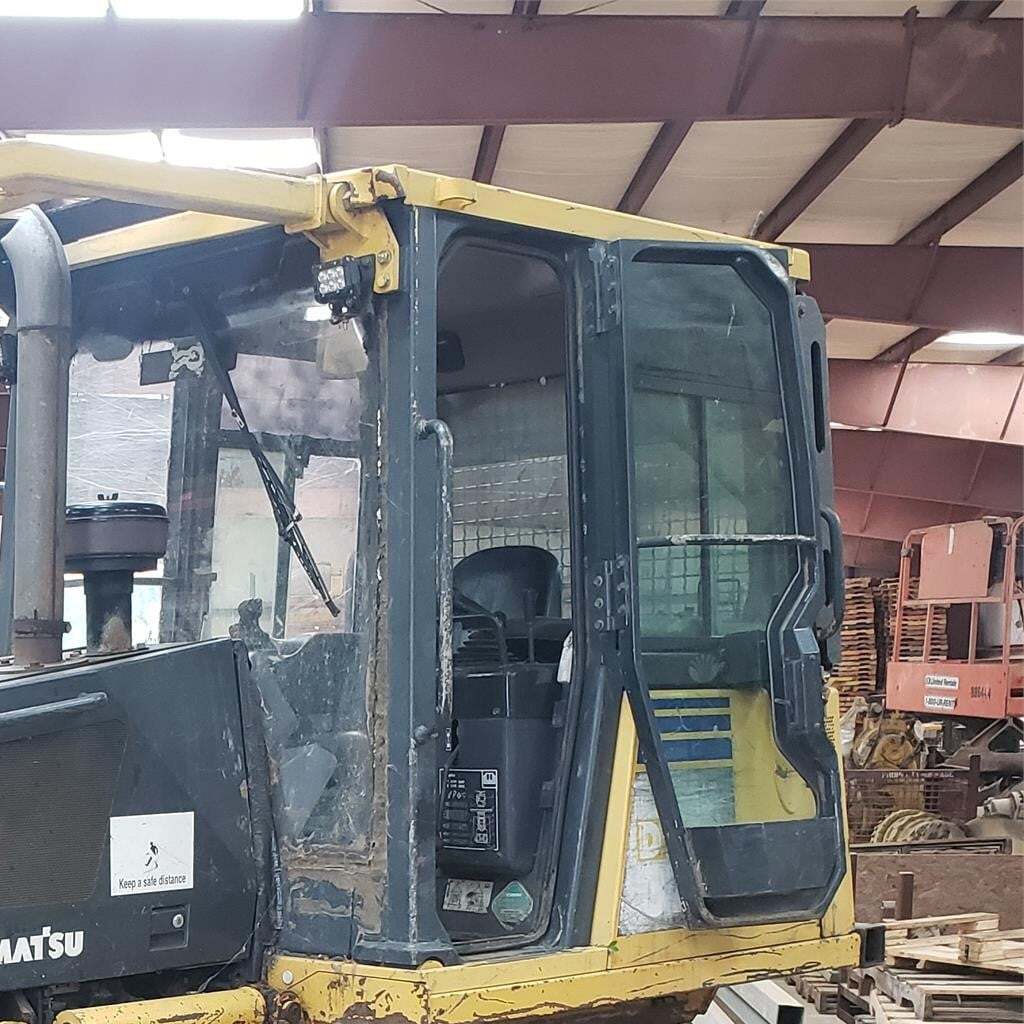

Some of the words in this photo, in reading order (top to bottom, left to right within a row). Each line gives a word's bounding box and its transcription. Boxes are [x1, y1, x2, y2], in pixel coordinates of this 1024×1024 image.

[119, 878, 136, 890] Keep
[137, 879, 142, 888] a
[143, 875, 157, 887] safe
[158, 874, 187, 886] distance
